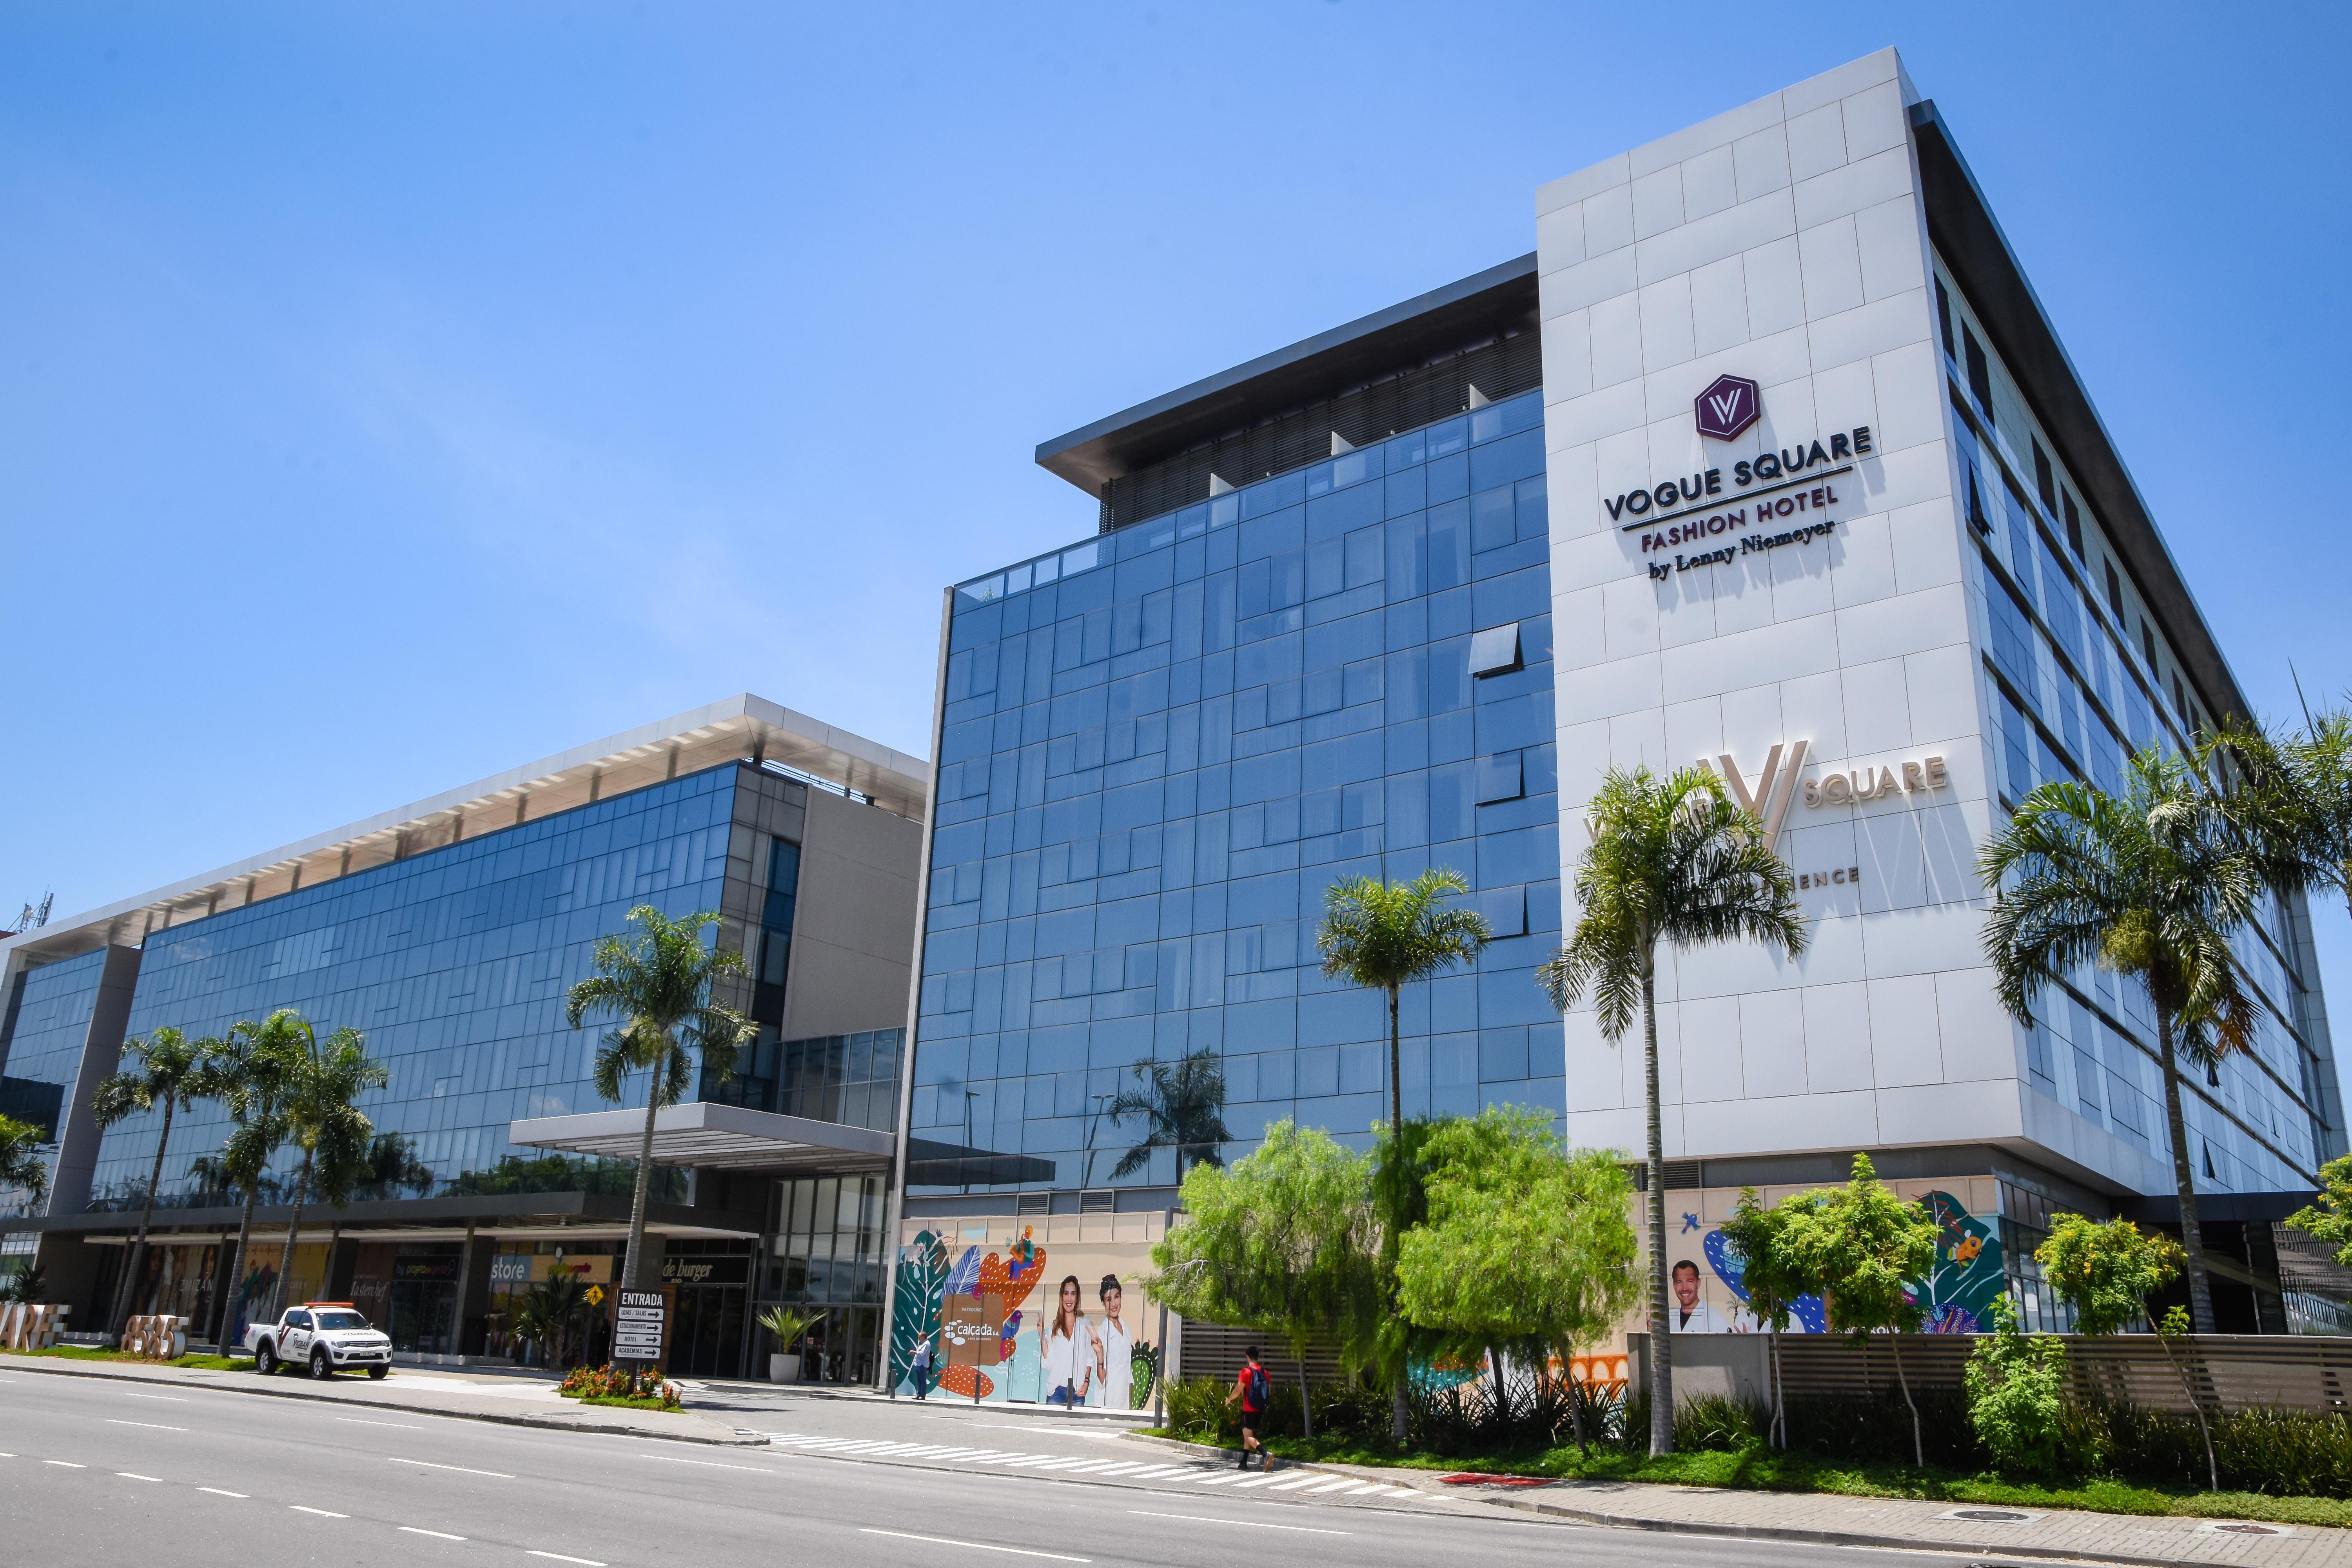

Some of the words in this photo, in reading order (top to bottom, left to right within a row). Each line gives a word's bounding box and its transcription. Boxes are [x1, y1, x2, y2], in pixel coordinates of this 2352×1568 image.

[1604, 468, 1721, 521] VOGUE
[1734, 425, 1871, 486] SQUARE
[1641, 508, 1746, 553] FASHION
[1757, 485, 1838, 523] HOTEL
[1648, 561, 1670, 581] by
[1675, 544, 1737, 572] Lenny
[1740, 519, 1836, 555] Niemeyer
[1804, 756, 1949, 808] SQUARE
[397, 1263, 405, 1276] by
[492, 1257, 524, 1279] store
[663, 1258, 676, 1276] de
[677, 1258, 713, 1281] burger
[350, 1281, 389, 1303] asterchef
[622, 1293, 662, 1306] ENTRADA
[121, 1314, 188, 1359] 8585
[957, 1323, 992, 1336] calçada
[293, 1339, 310, 1348] VIGBAN
